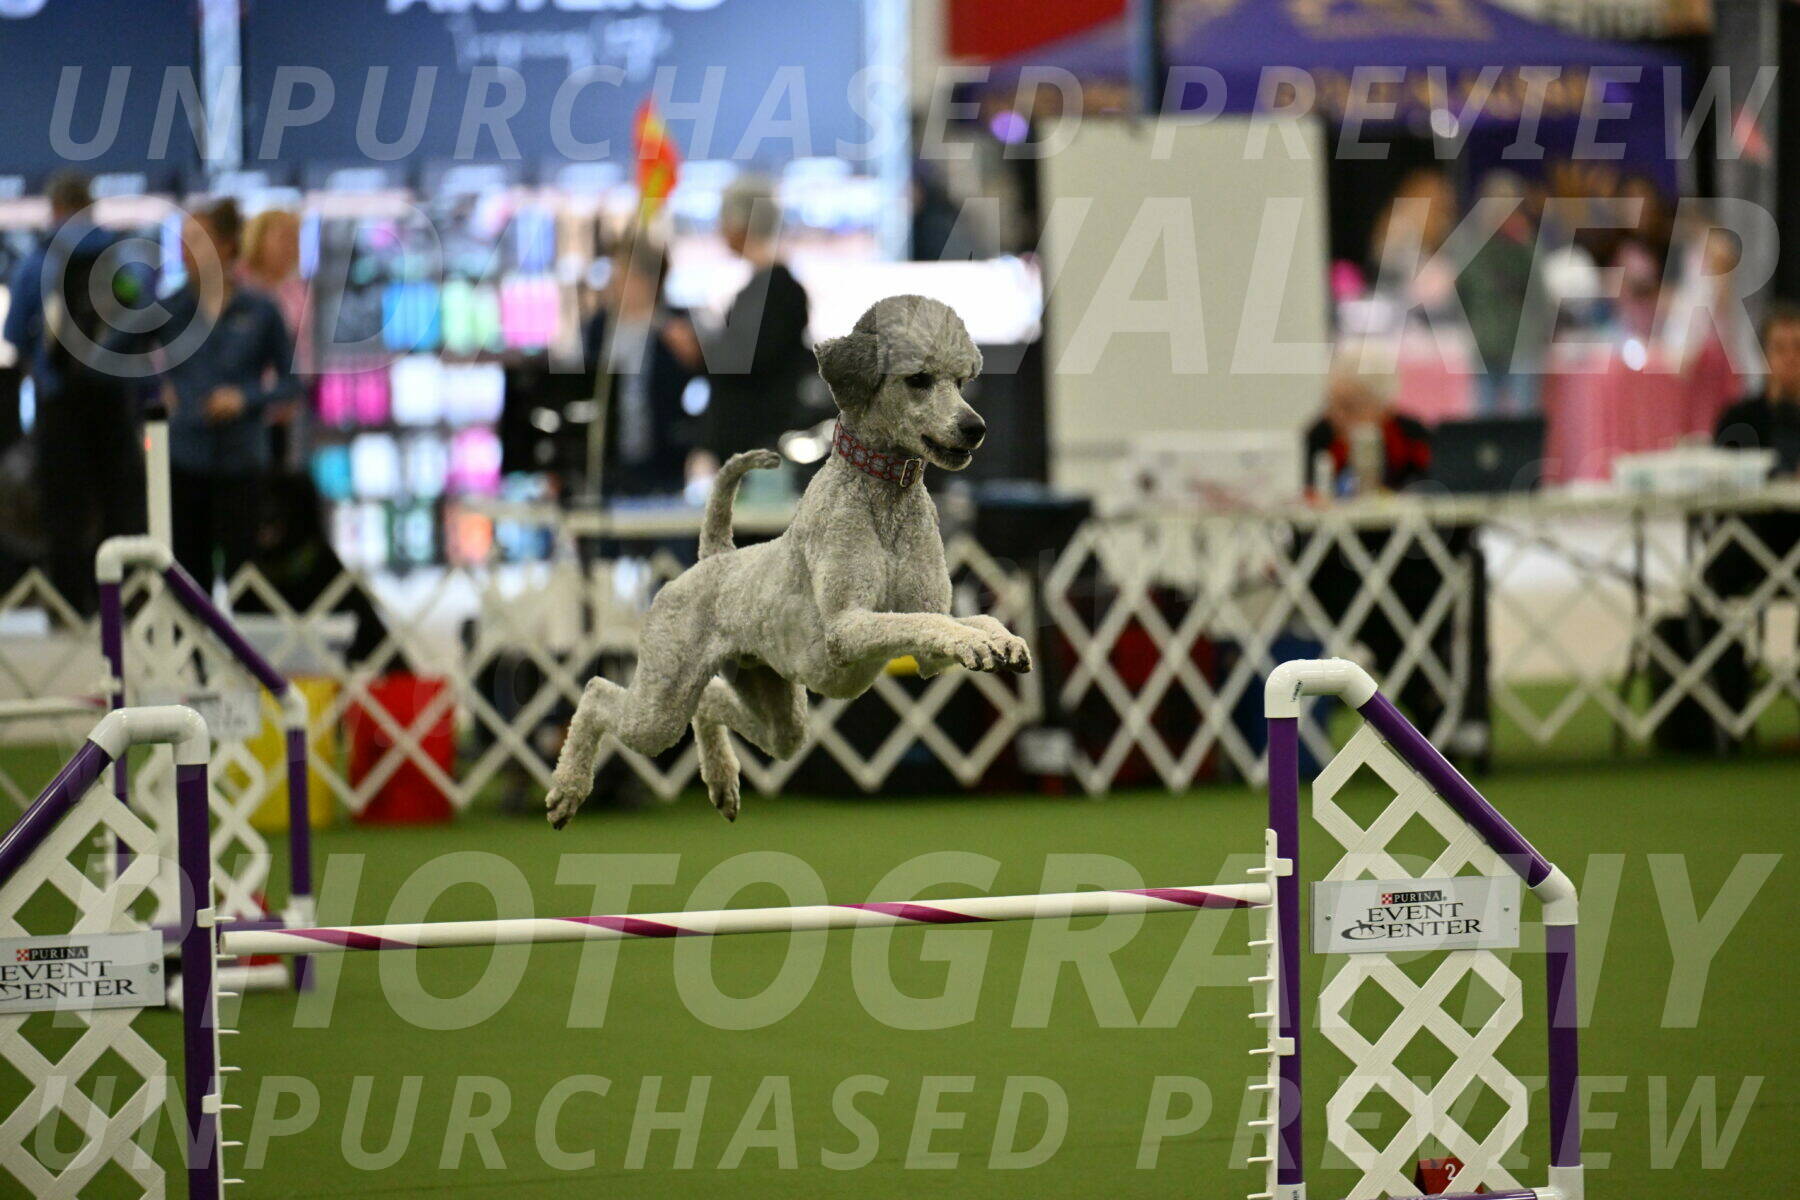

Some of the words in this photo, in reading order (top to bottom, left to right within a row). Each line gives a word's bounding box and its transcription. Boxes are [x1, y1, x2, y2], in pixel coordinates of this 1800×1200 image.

[1393, 891, 1441, 903] PURINA
[1368, 903, 1464, 922] EVENT
[1341, 919, 1483, 940] CENTER
[30, 946, 87, 960] PURINA
[0, 960, 112, 981] EVENT
[1445, 1163, 1456, 1180] 2
